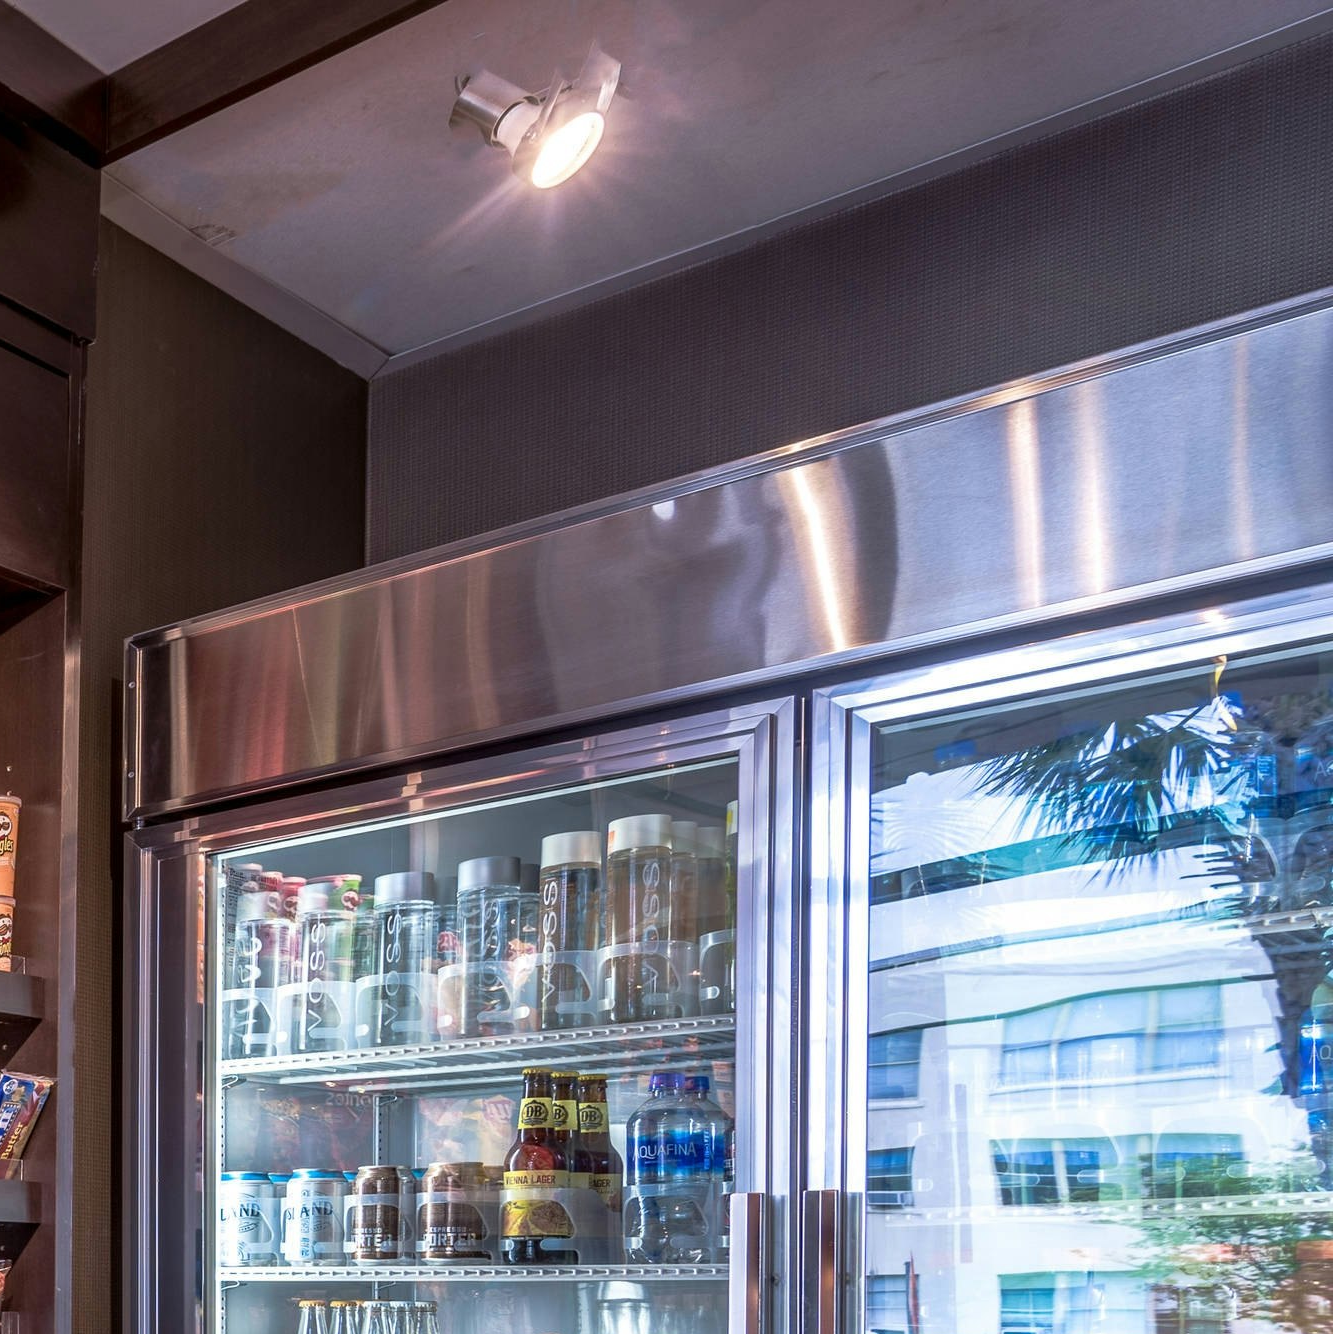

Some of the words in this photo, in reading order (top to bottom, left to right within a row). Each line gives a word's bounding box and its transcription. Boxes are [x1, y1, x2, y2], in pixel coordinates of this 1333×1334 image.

[0, 1122, 24, 1160] Butter
[633, 1141, 697, 1160] AQUAFINA
[531, 1173, 556, 1185] LAGER
